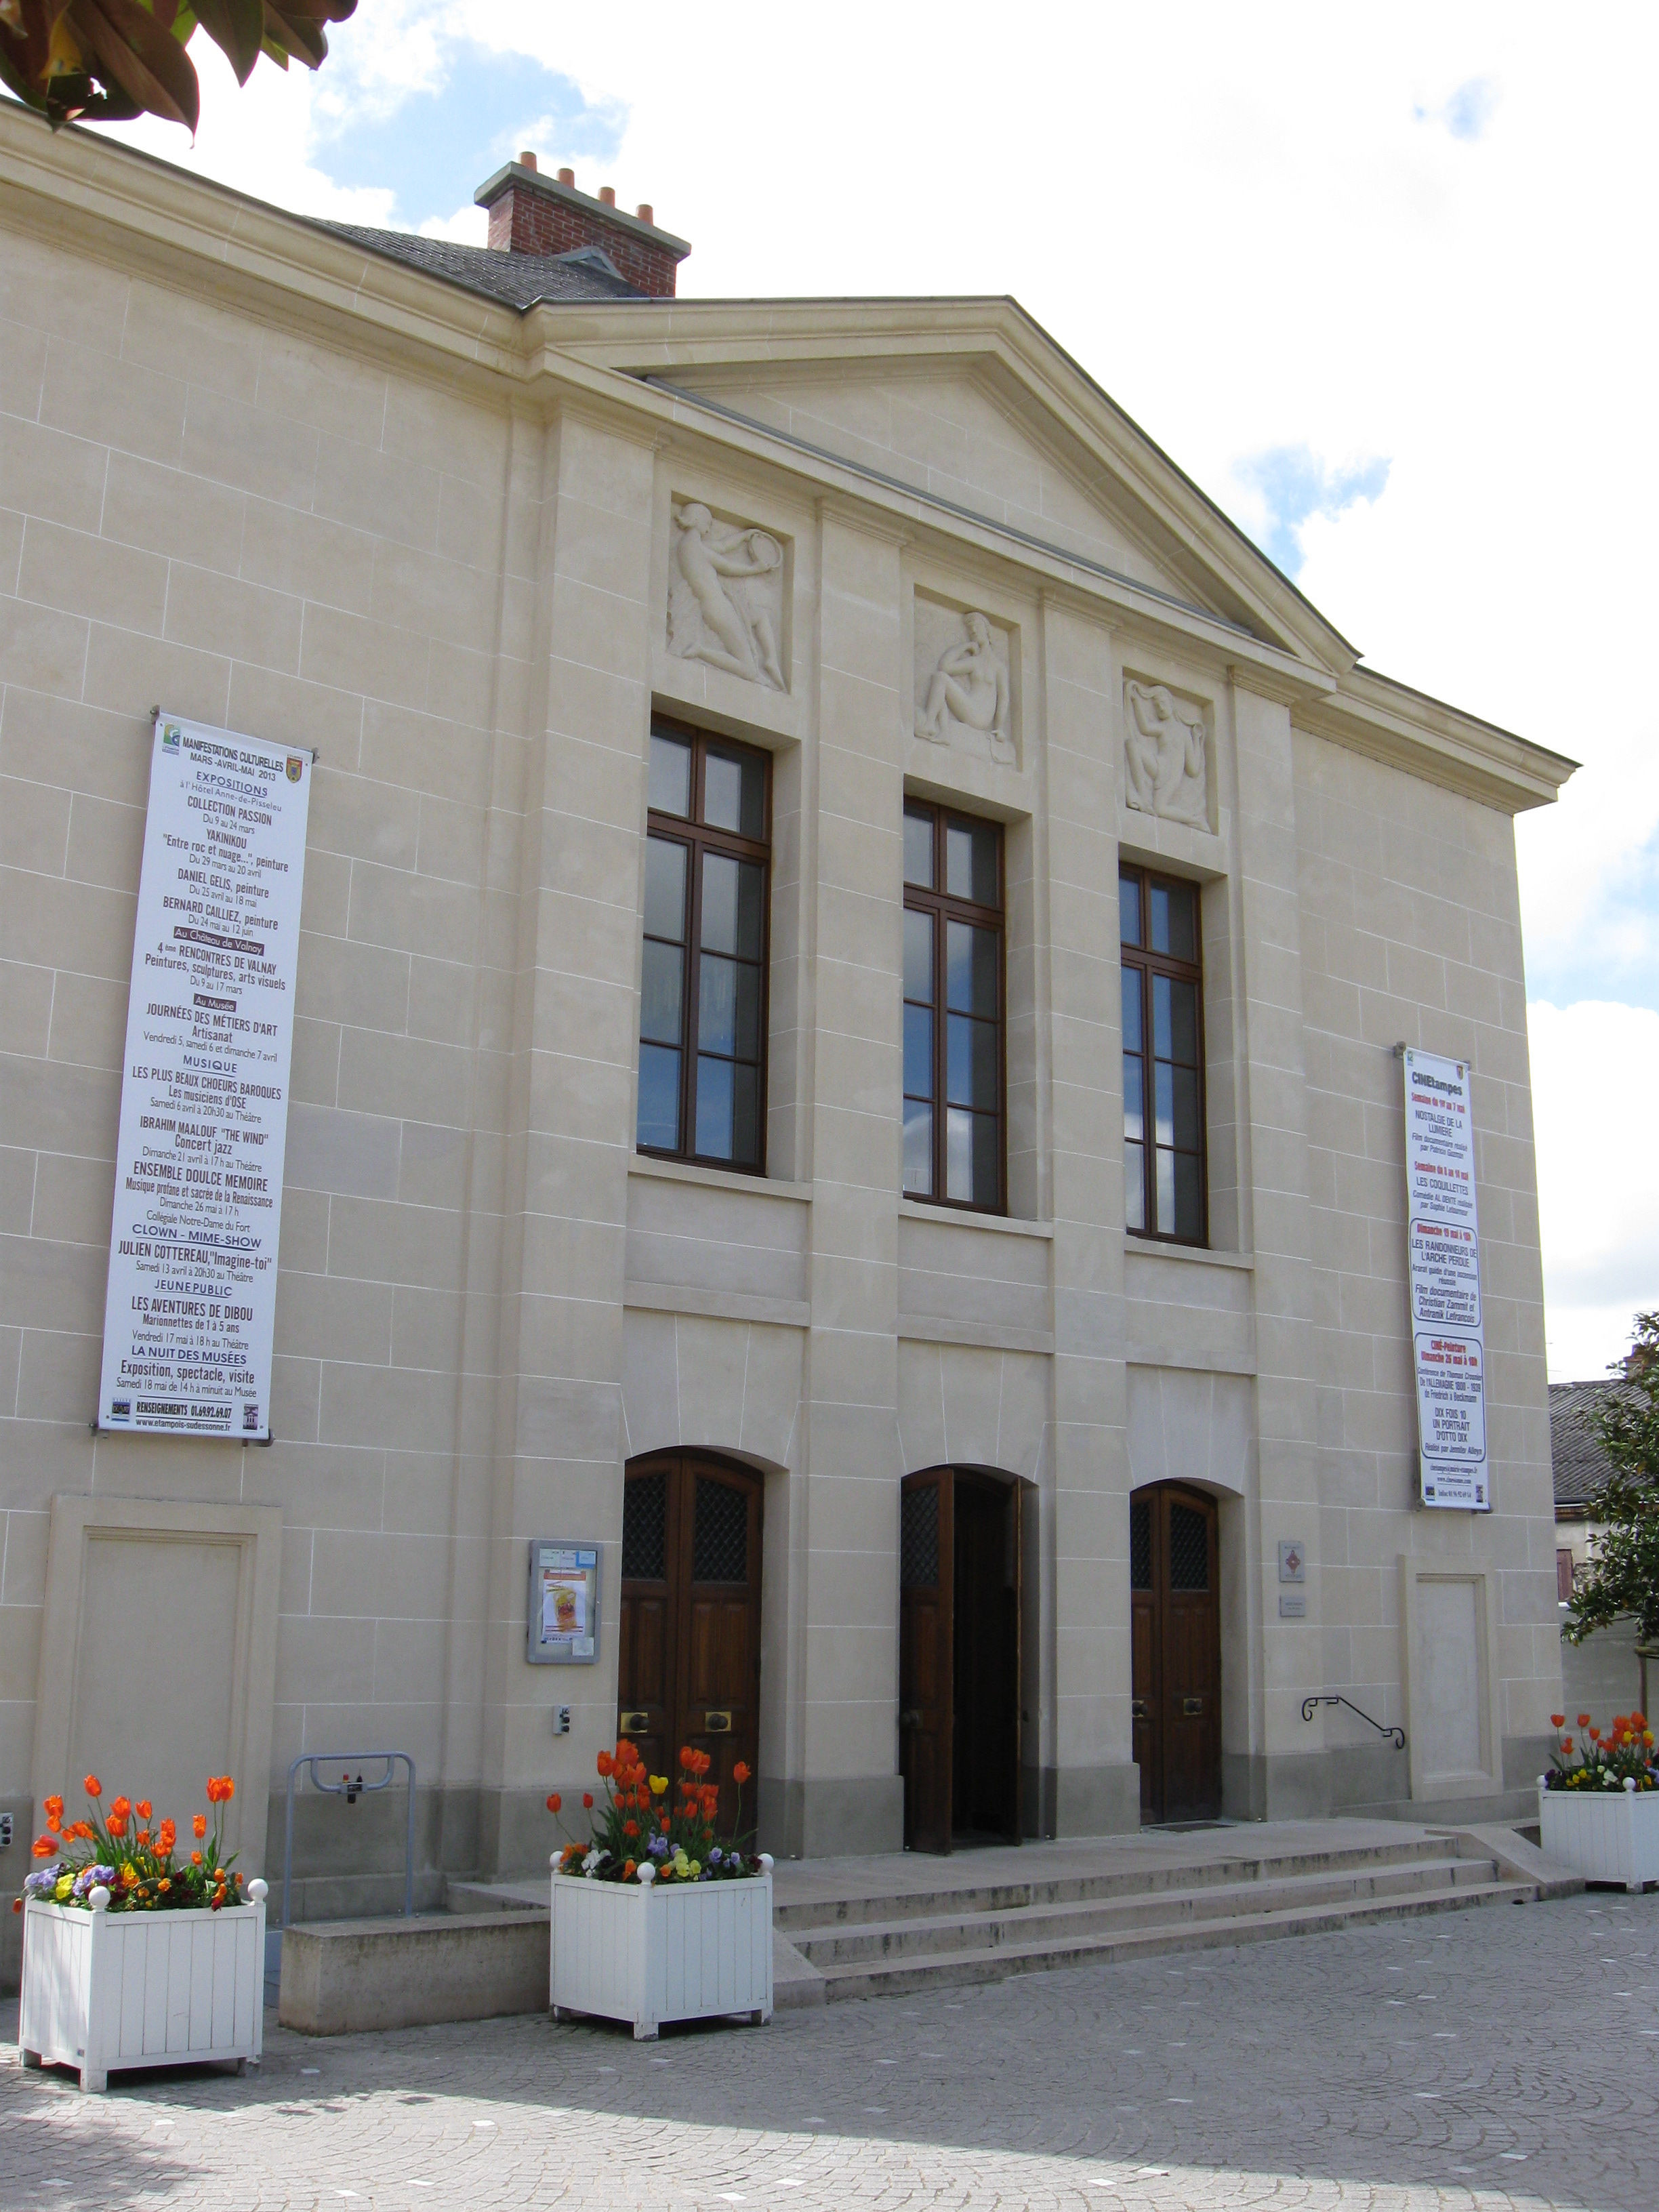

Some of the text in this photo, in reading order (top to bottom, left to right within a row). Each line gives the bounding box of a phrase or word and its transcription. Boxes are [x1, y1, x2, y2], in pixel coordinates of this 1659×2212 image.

[182, 737, 238, 760] MANIFESTATIONS
[239, 752, 283, 772] CULTURELLES
[197, 771, 267, 796] EXPOSITIONS
[258, 770, 275, 781] 2013
[187, 796, 271, 825] COLLECTION PASSION
[215, 788, 281, 811] Anne-de-Pisseleu
[206, 828, 247, 848] YAKINIKOU
[163, 834, 188, 849] "Entre
[191, 842, 205, 853] roc
[208, 845, 216, 855] et
[256, 857, 288, 872] peinture
[178, 868, 268, 898] DANIEL GELIS, peinture
[163, 896, 278, 930] BERNARD CAILLIEZ, peinture
[175, 928, 262, 954] Au Château de Valnay
[157, 942, 163, 953] 4
[179, 945, 231, 966] RENCONTRES
[234, 956, 245, 968] DE
[247, 958, 276, 975] VALNAY
[145, 953, 285, 990] Peintures, sculptures, arts visuels
[195, 996, 234, 1010] Au Musée
[146, 1003, 277, 1036] JOURNÉES DES MÉTIERS D'ART
[192, 1025, 232, 1043] Artisanat
[144, 1031, 176, 1044] Vendredi
[186, 1040, 207, 1050] samedi
[209, 1042, 213, 1052] 6
[224, 1045, 255, 1059] dimanche
[258, 1050, 262, 1059] 7
[263, 1053, 277, 1062] avril
[183, 1054, 237, 1073] MUSIQUE
[132, 1066, 281, 1100] LES PLUS BEAUX CHOEURS BAROQUES
[169, 1084, 246, 1109] Les musiciens d'OSE
[140, 1115, 268, 1145] IBRAHIM MAALOUF "THE WIND"
[1446, 1117, 1454, 1127] DE
[175, 1134, 232, 1155] Concert jazz
[134, 1161, 268, 1191] ENSEMBLE DOULCE MEMOIRE
[1416, 1176, 1468, 1195] LES COQUILLETTES
[125, 1176, 272, 1208] Musique profane et sacrée de la Renaissance
[132, 1224, 177, 1238] CLOWN
[179, 1214, 223, 1229] Notre-Dame
[225, 1221, 234, 1230] du
[235, 1221, 250, 1232] Fort
[118, 1240, 151, 1256] JULIEN
[1412, 1239, 1477, 1258] LES RANDONNEURS DE
[136, 1260, 160, 1272] Samedi
[162, 1263, 169, 1273] 13
[171, 1265, 187, 1275] avril
[194, 1267, 215, 1278] 20h30
[226, 1270, 253, 1282] Théâtre
[1415, 1284, 1476, 1301] Film documentaire de
[131, 1296, 252, 1321] LES AVENTURES DE DIBOU
[142, 1313, 192, 1328] Marionnettes
[195, 1319, 204, 1330] de
[206, 1319, 209, 1330] 1
[219, 1321, 224, 1332] 5
[226, 1324, 239, 1333] ans
[131, 1345, 246, 1364] LA NUIT DES MUSÉES
[121, 1359, 254, 1383] Exposition, spectacle, visite
[136, 1401, 187, 1415] RENSEIGNEMENTS
[191, 1405, 232, 1418] 01.69.92.69.07
[1433, 1418, 1469, 1431] UN PORTRAIT
